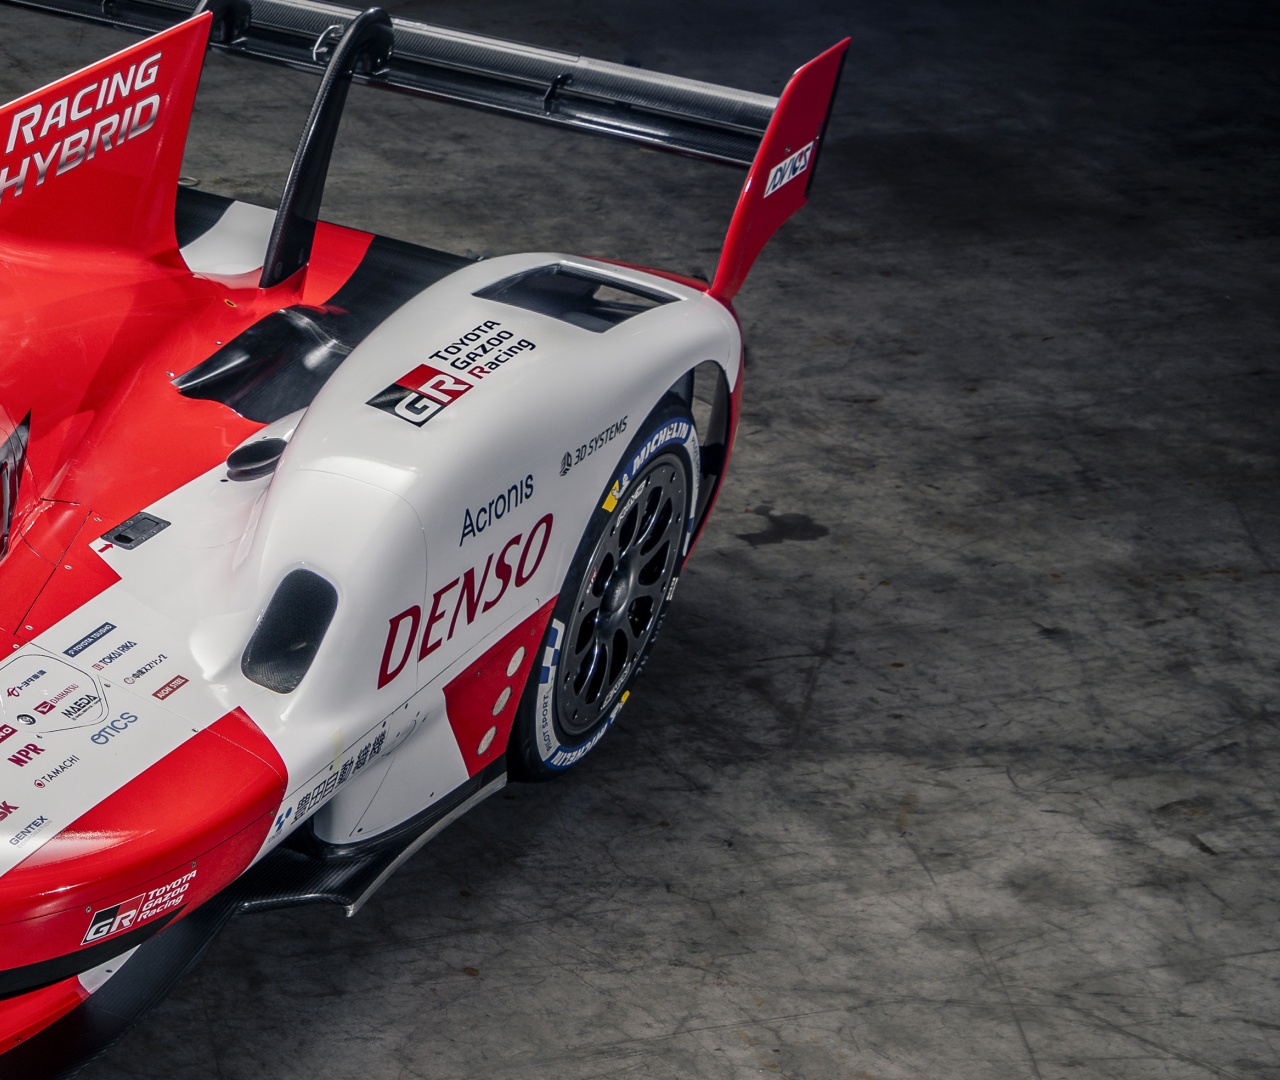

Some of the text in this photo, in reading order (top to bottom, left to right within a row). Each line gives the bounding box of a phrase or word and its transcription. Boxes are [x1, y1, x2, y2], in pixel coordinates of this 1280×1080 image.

[5, 51, 162, 154] RACING
[429, 320, 501, 362] TOYOTA
[449, 330, 514, 371] GAZOO
[471, 337, 536, 380] Racing
[394, 373, 467, 423] GR
[573, 415, 628, 466] 3D SYSTEMS
[631, 422, 689, 475] MICHELIN
[459, 473, 534, 547] Acronis
[376, 513, 554, 690] DENSO
[49, 683, 79, 705] DAIHATSU
[61, 694, 98, 718] MAEDA
[90, 711, 138, 746] OTICS
[7, 743, 46, 768] NPR
[41, 754, 80, 783] TAMACHI
[9, 815, 48, 846] GENTEX
[142, 883, 190, 911] GAZOO
[148, 870, 197, 900] TOYOTA
[86, 909, 137, 941] GR
[136, 894, 184, 922] Racing
